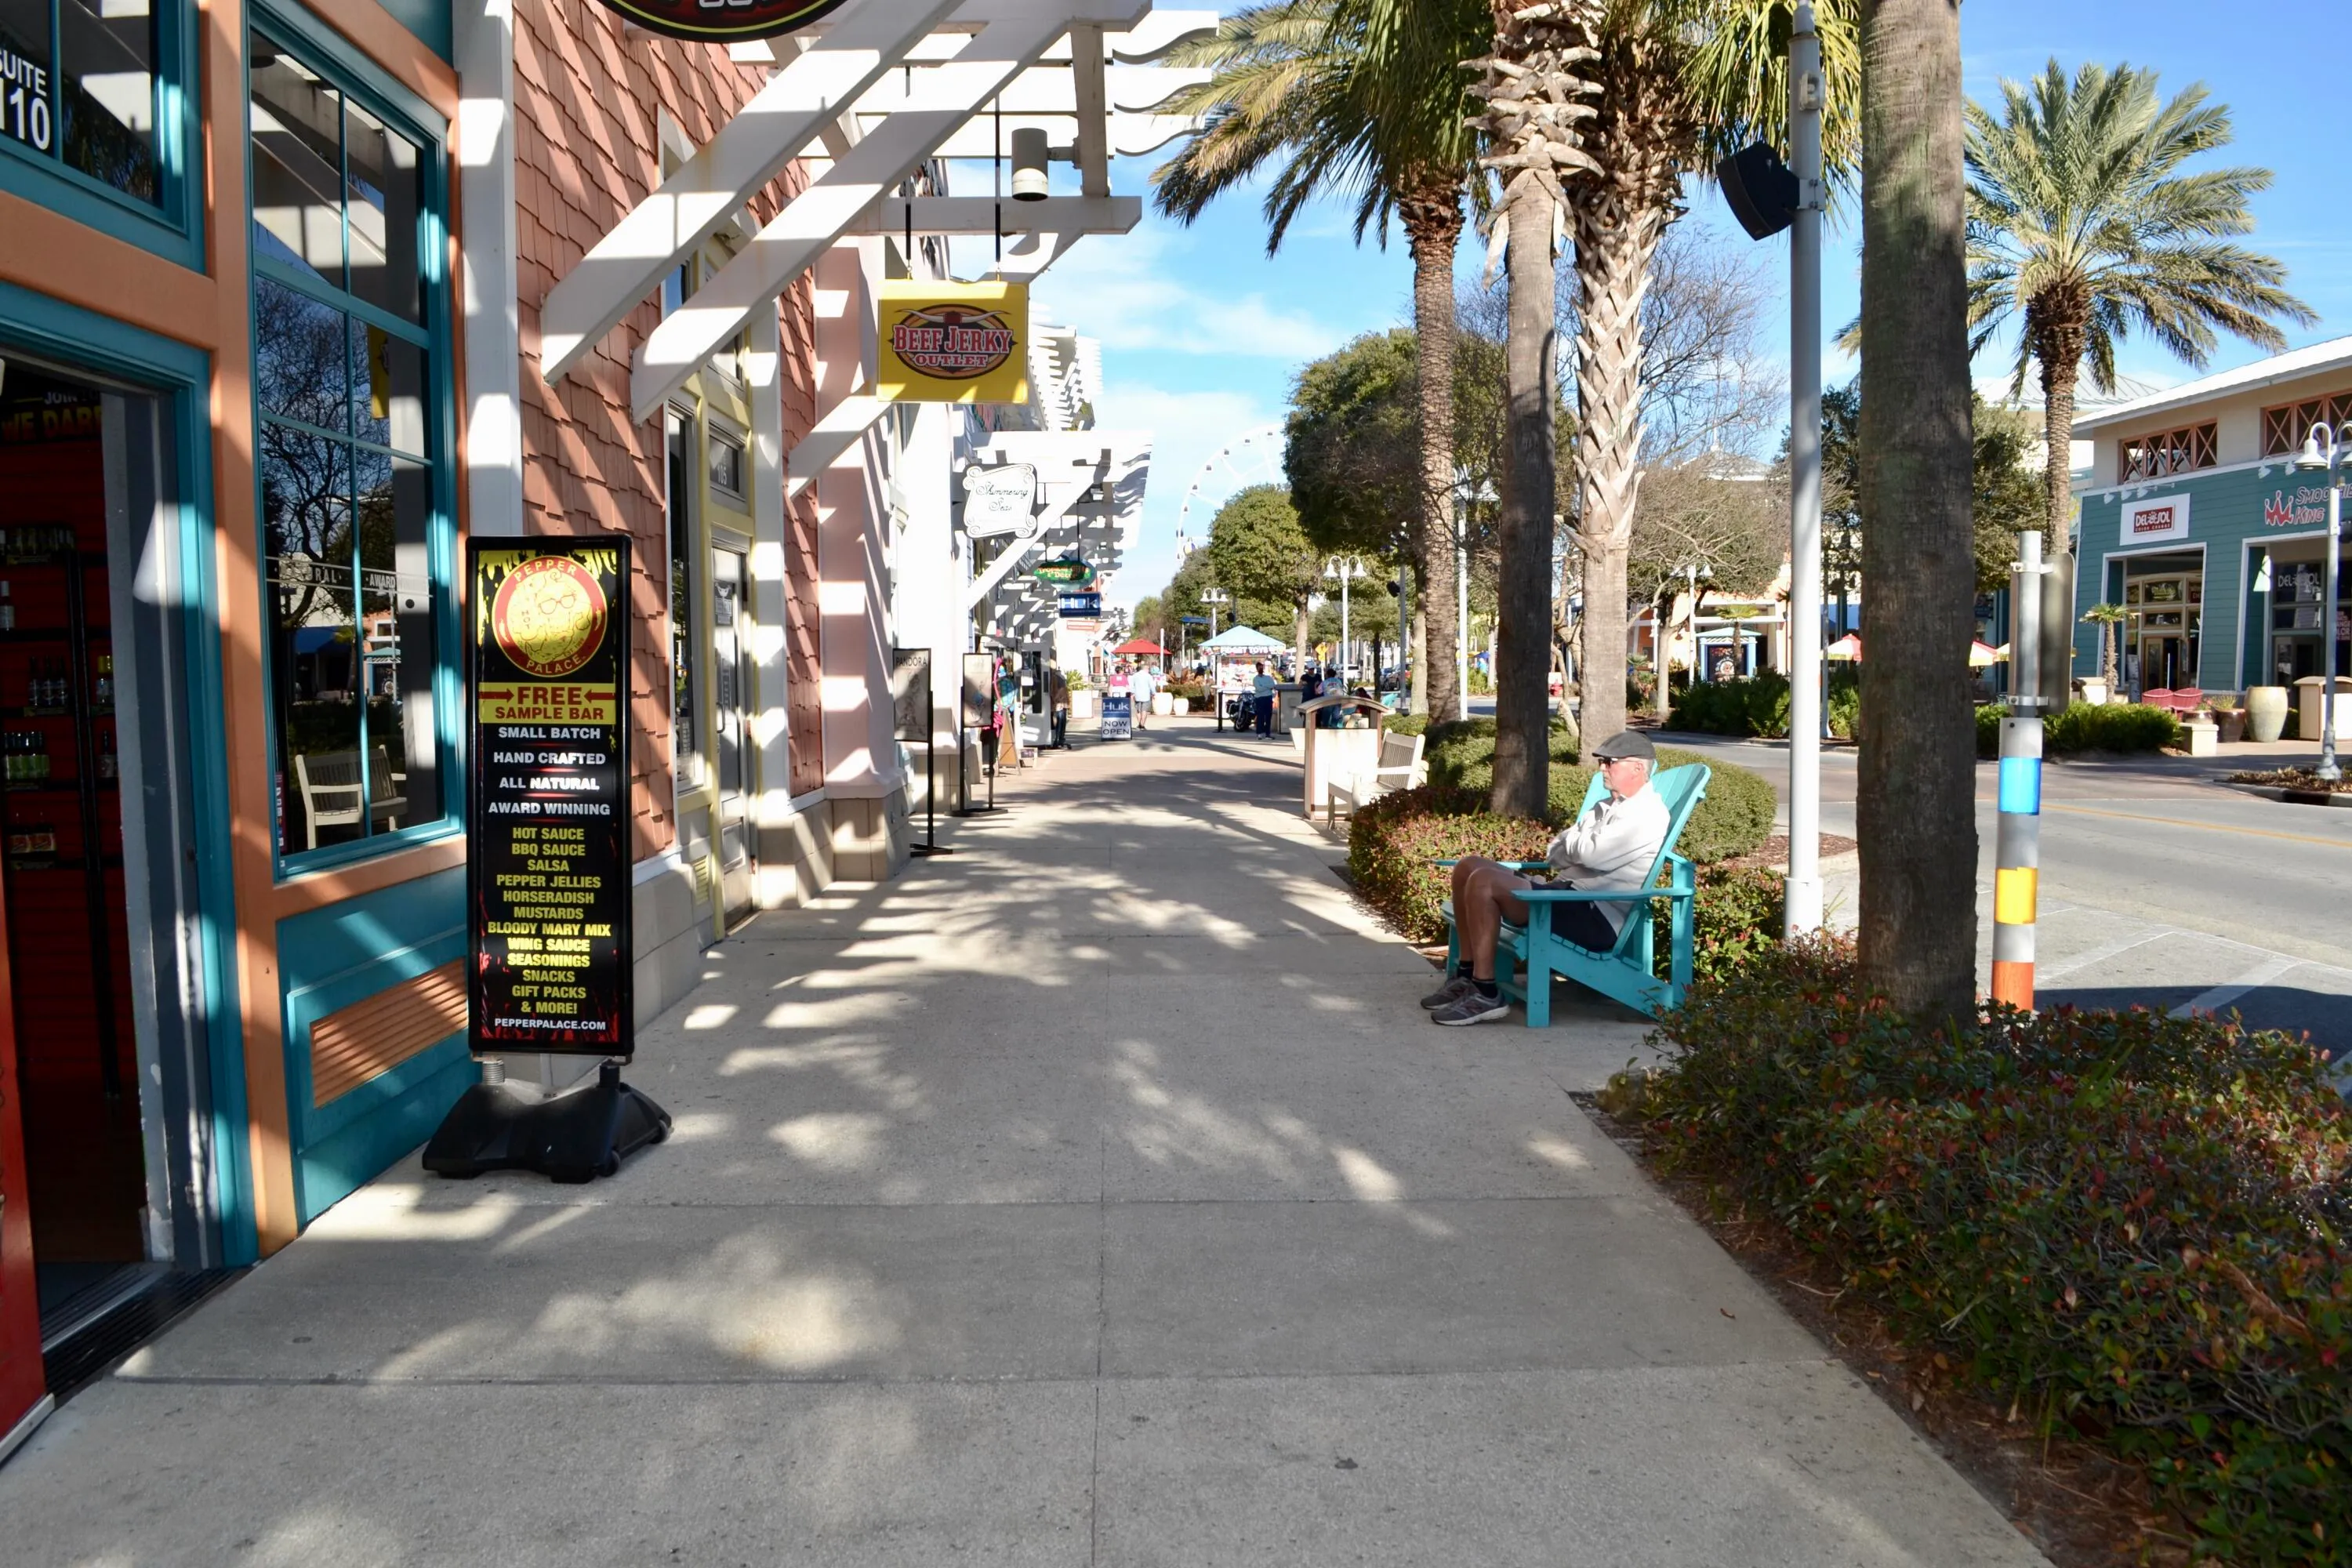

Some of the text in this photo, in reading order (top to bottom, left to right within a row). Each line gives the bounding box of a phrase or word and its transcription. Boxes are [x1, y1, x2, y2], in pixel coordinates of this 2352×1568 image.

[893, 325, 1013, 354] BEEF JERKY
[913, 353, 989, 367] OUTLET
[976, 481, 1029, 499] Shimmering
[2135, 514, 2148, 527] DEL
[2294, 506, 2325, 525] KING
[514, 559, 578, 582] PEPPER
[369, 573, 396, 588] AWARD
[527, 654, 582, 674] PALACE
[895, 657, 927, 666] PANDORA
[517, 687, 583, 705] FREE
[1102, 702, 1129, 710] Huk
[495, 708, 604, 720] SAMPLE BAR
[499, 728, 601, 739] SMALL BATCH
[493, 753, 606, 764] HAND CRAFTED
[499, 778, 600, 790] ALL NATURAL
[488, 802, 611, 816] AWARD WINNING
[513, 828, 585, 840] HOT SAUCE
[512, 844, 586, 857] BBQ SAUCE
[528, 859, 569, 872] SALSA
[496, 875, 601, 888] PEPPER JELLIES
[503, 891, 594, 904] HORSERADISH
[514, 907, 583, 920] MUSTARDS
[488, 922, 611, 937] BLOODY MARY MIX
[507, 938, 590, 952] WING SAUCE
[507, 953, 590, 967] SEASONINGS
[523, 970, 575, 982] SNACKS
[512, 985, 586, 999] GIFT PACKS
[521, 1001, 577, 1014] & MORE!
[495, 1018, 606, 1030] PEPPERPALACE.COM
